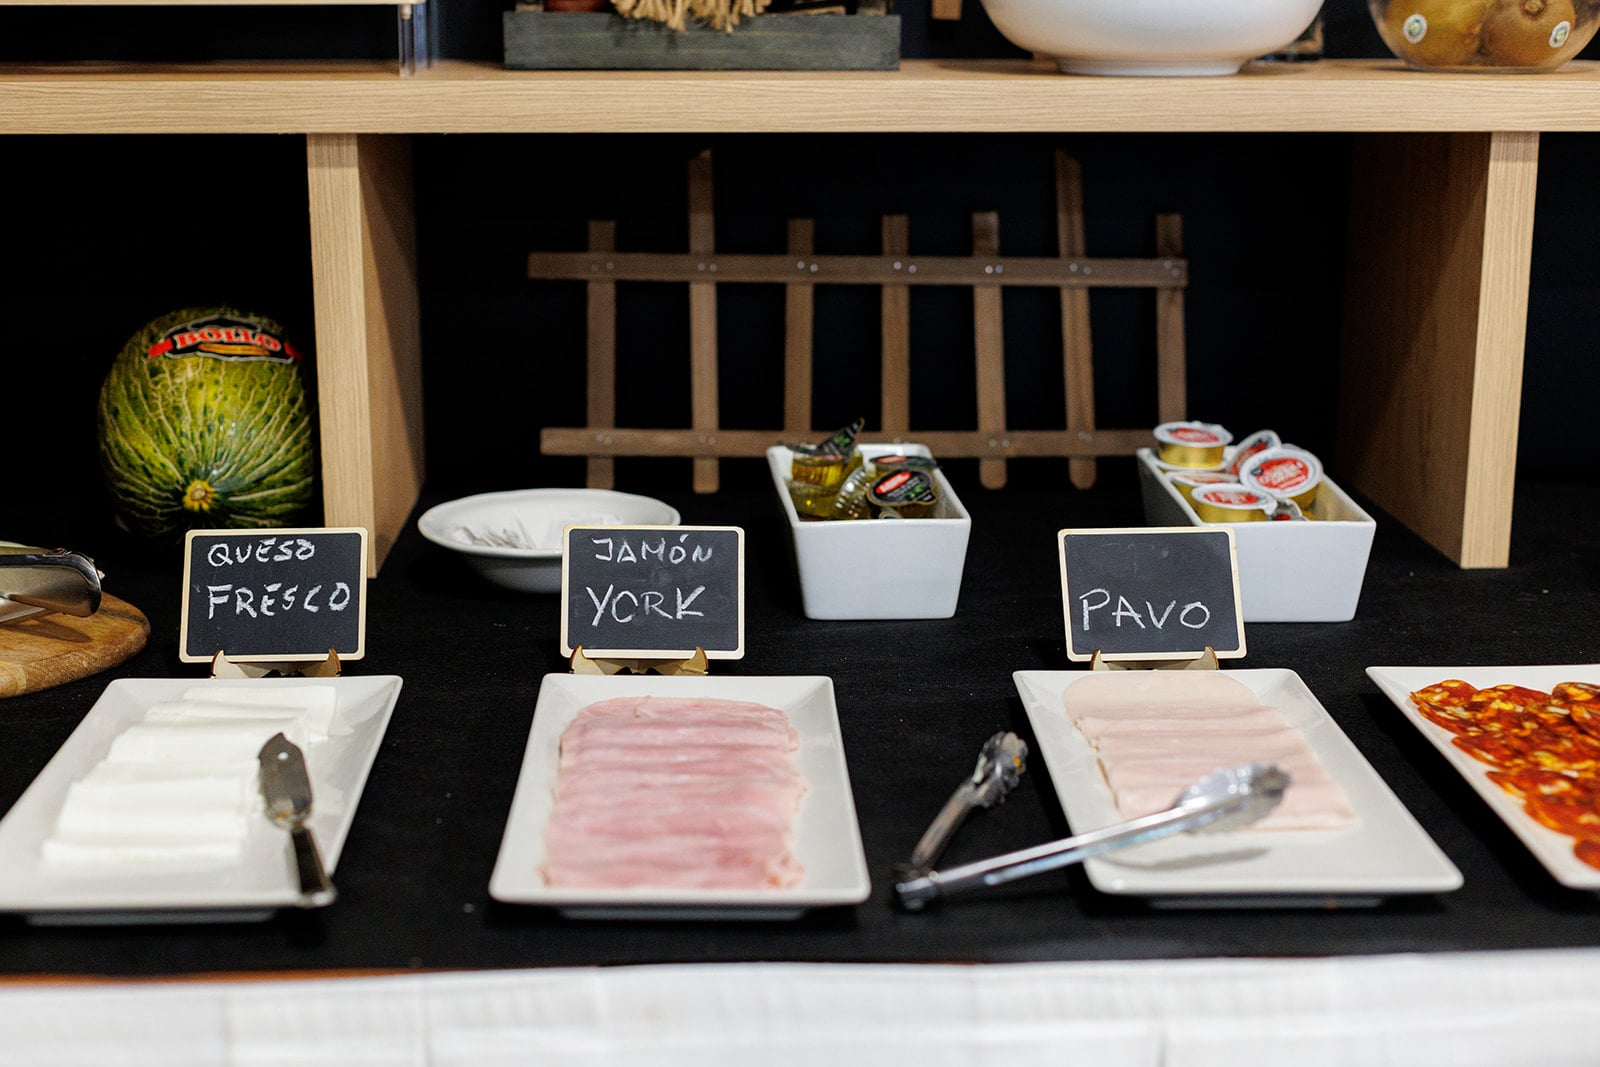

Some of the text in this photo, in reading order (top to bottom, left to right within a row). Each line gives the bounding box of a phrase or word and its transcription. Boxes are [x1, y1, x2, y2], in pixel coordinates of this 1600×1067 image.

[174, 326, 281, 351] BOLLO
[207, 537, 315, 567] QUESO
[592, 534, 712, 565] JAMÓN
[207, 582, 350, 620] FRESCO
[586, 584, 706, 627] YORK
[1079, 588, 1211, 631] PAVO
